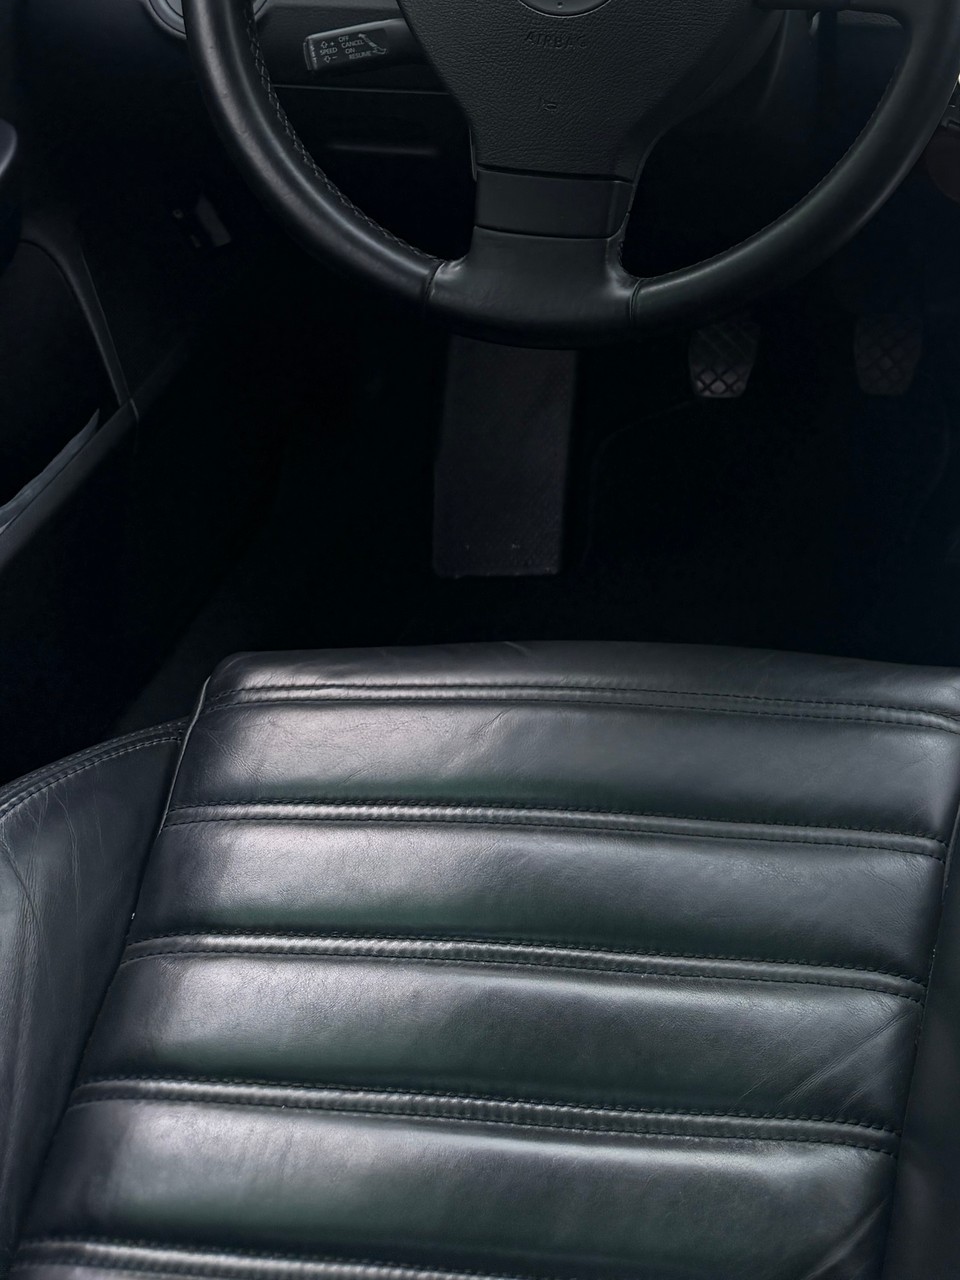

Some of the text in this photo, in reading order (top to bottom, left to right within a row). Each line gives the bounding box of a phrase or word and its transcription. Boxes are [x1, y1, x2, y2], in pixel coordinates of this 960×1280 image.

[338, 35, 350, 43] OFF
[341, 39, 365, 49] CANCEL
[320, 46, 338, 56] SPEED
[345, 47, 356, 55] ON
